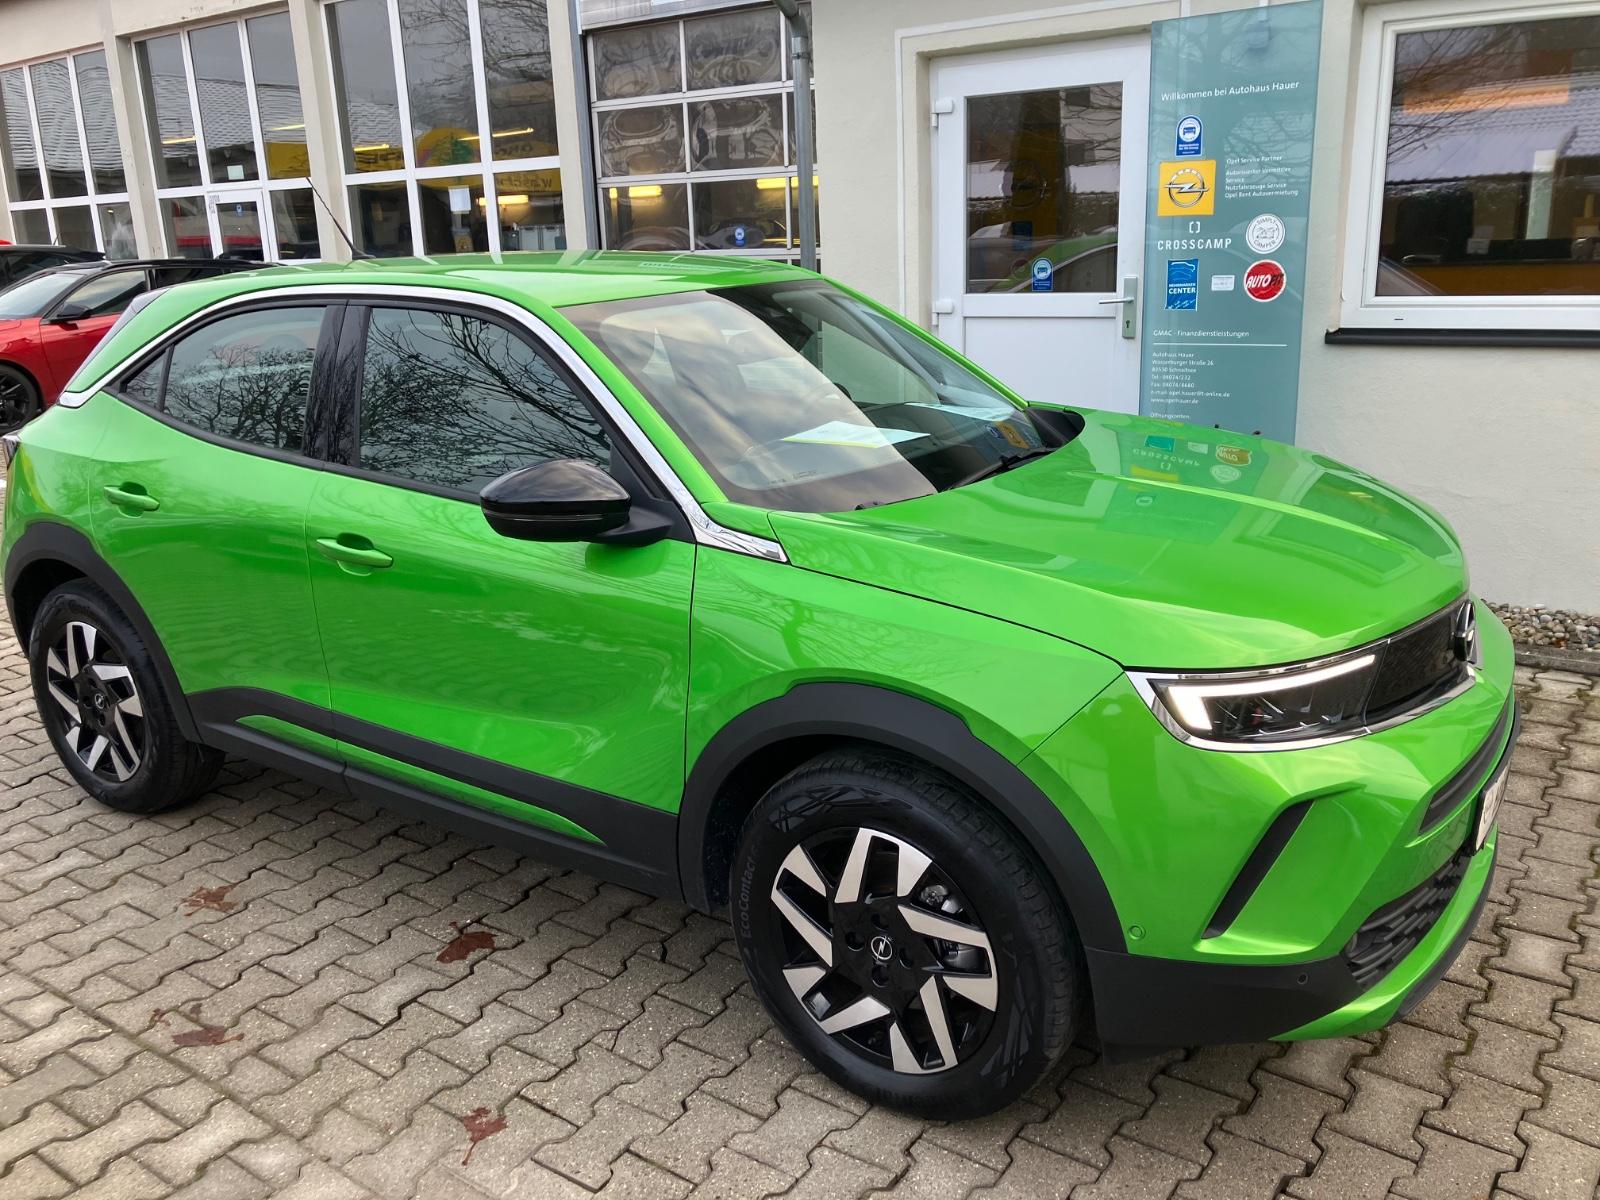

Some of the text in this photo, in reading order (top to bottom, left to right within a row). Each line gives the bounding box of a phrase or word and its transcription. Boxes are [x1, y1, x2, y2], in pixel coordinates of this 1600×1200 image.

[1161, 81, 1300, 102] Willkommen bei Autohaus Hauer
[1226, 157, 1240, 165] Opel
[1241, 156, 1260, 164] Service
[1256, 216, 1277, 225] SIMPLY
[1157, 238, 1232, 251] CROSSCAMP
[1253, 239, 1277, 249] CAMPER
[1168, 287, 1197, 295] CENTER
[1153, 329, 1172, 337] GMAC
[1177, 329, 1250, 338] Finanzdienstleistungen
[738, 856, 757, 939] EcoContact
